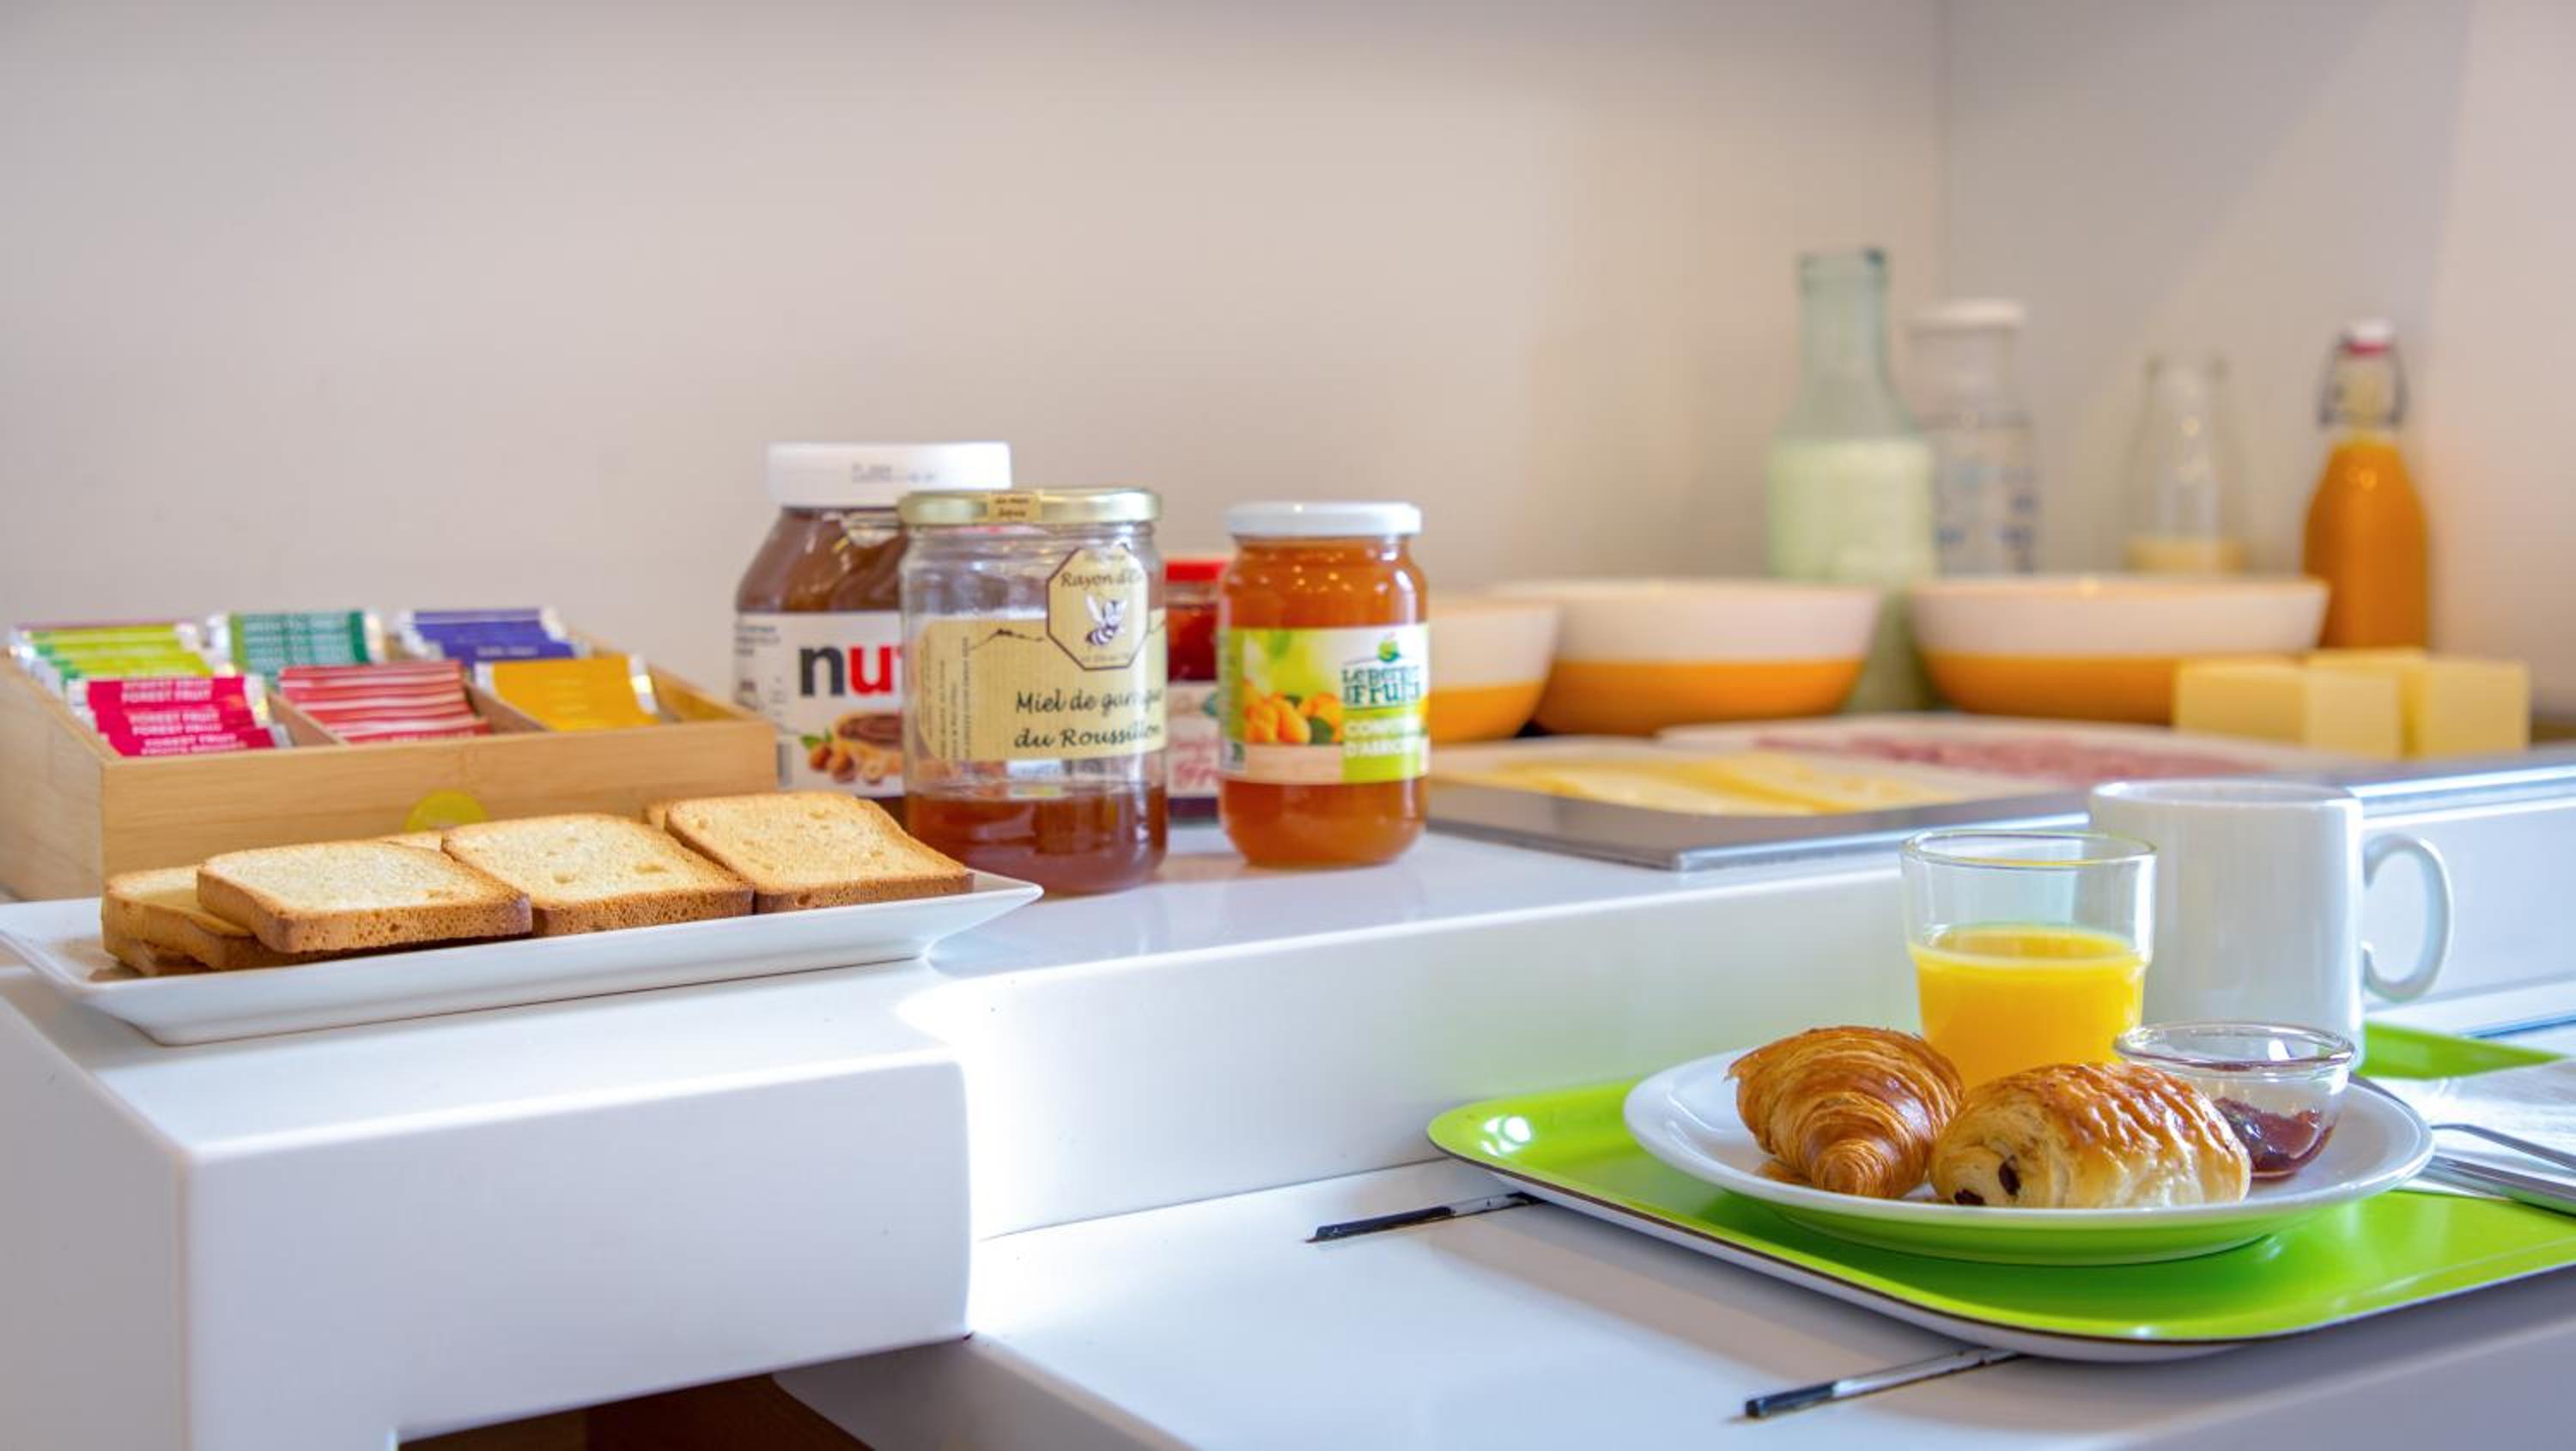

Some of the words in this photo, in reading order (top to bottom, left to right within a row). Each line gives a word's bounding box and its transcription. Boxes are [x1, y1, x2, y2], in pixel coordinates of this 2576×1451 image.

[1060, 571, 1113, 591] Rayon
[799, 646, 902, 698] nu
[1016, 688, 1066, 714] Miel
[1069, 689, 1098, 711] de
[1014, 728, 1056, 748] du
[1060, 719, 1162, 749] Roussilon
